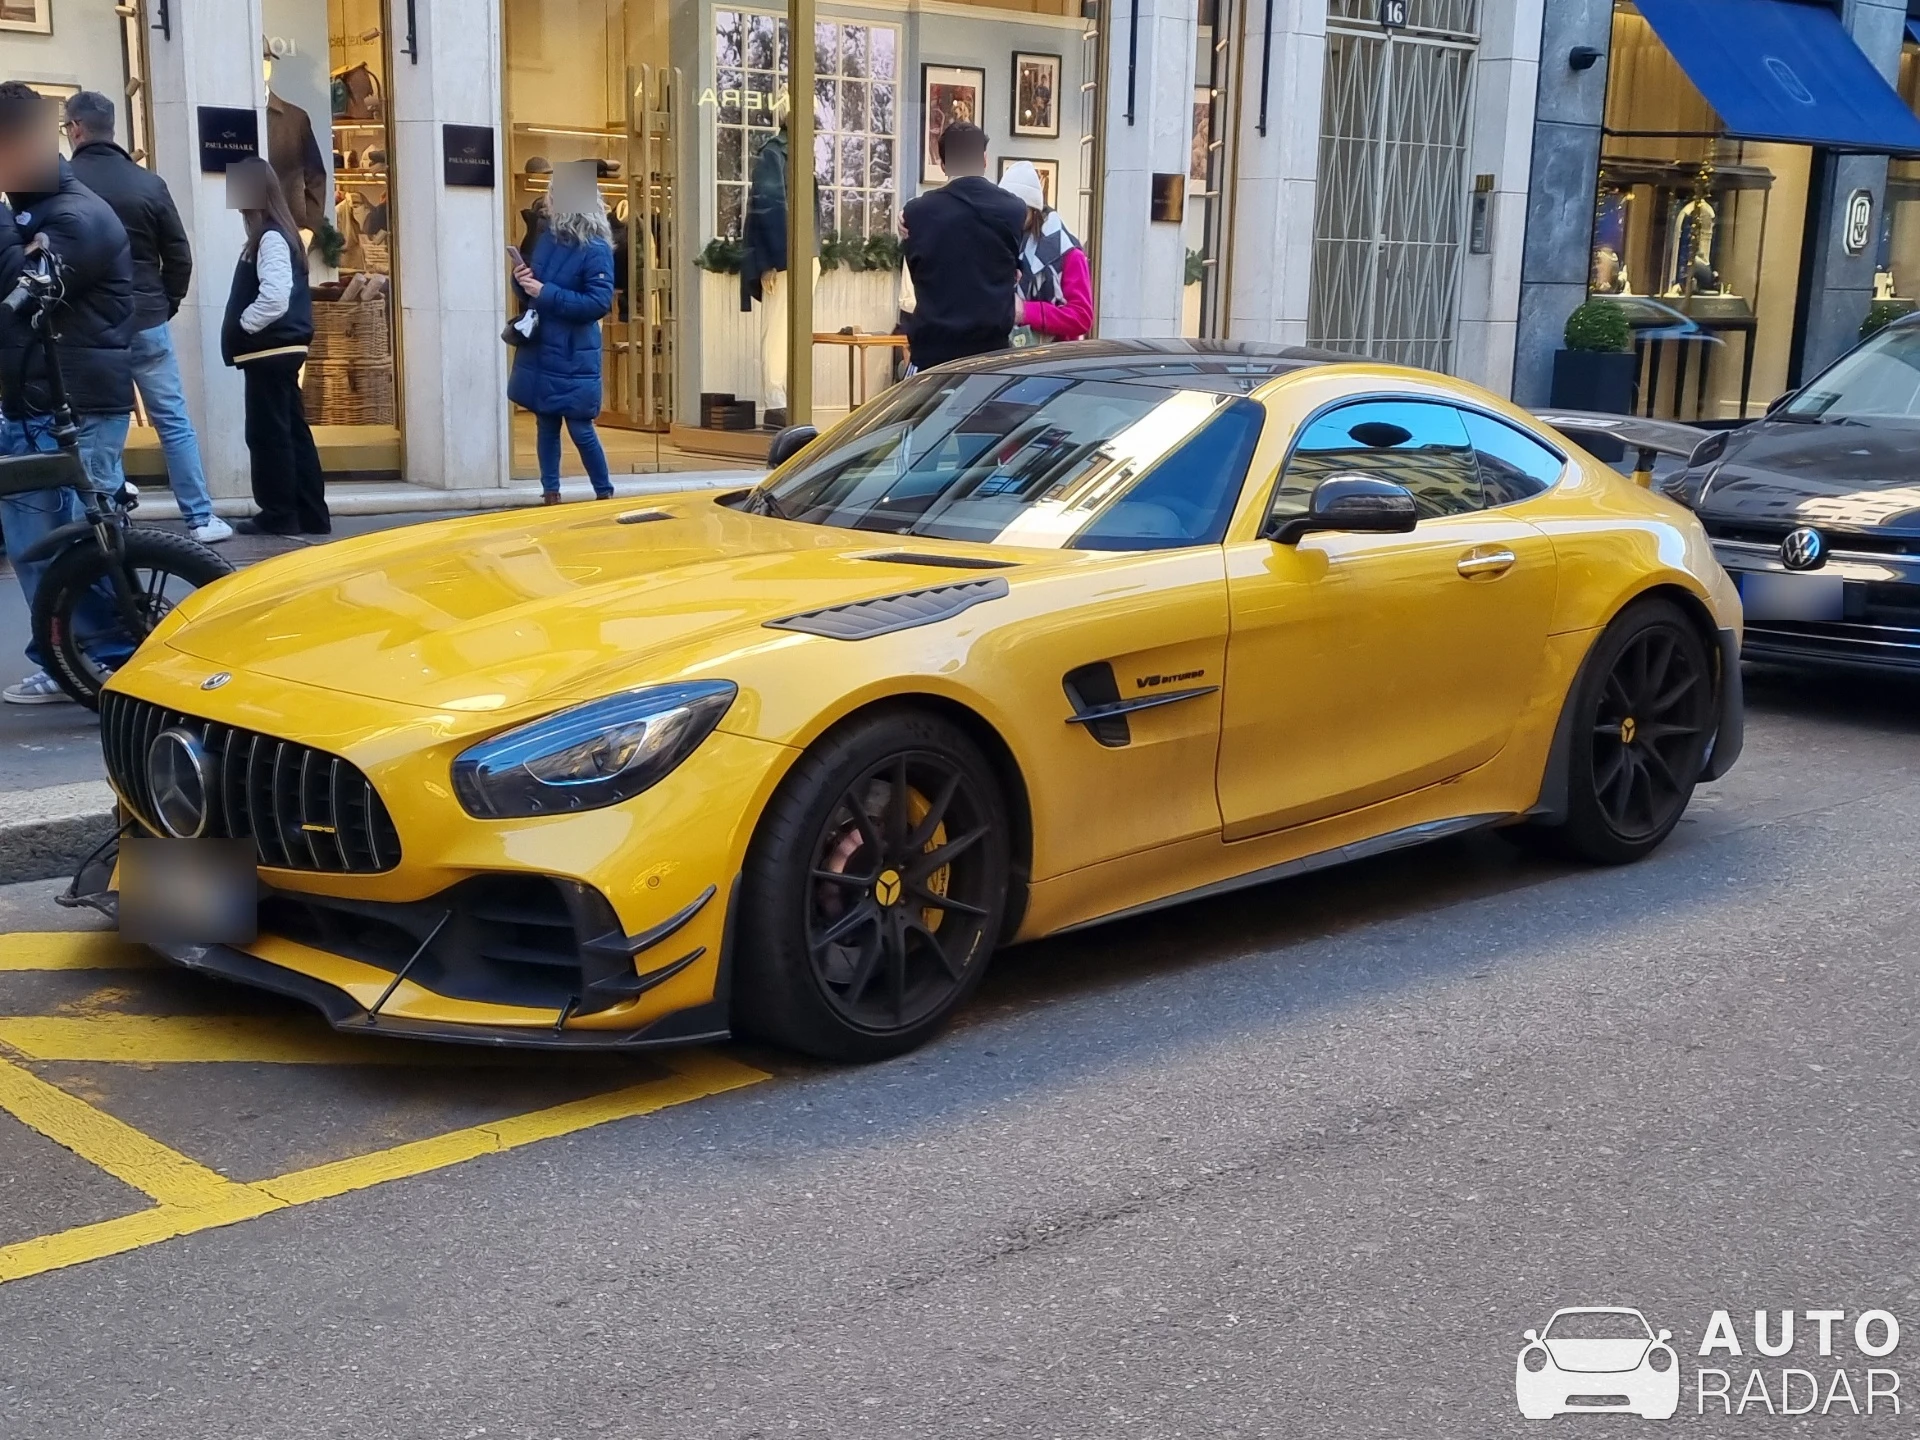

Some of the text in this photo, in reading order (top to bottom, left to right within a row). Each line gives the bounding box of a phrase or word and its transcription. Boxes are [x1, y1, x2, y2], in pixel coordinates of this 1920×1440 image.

[1387, 1, 1403, 23] 16
[205, 141, 223, 149] PAUL
[229, 143, 254, 151] SHARK
